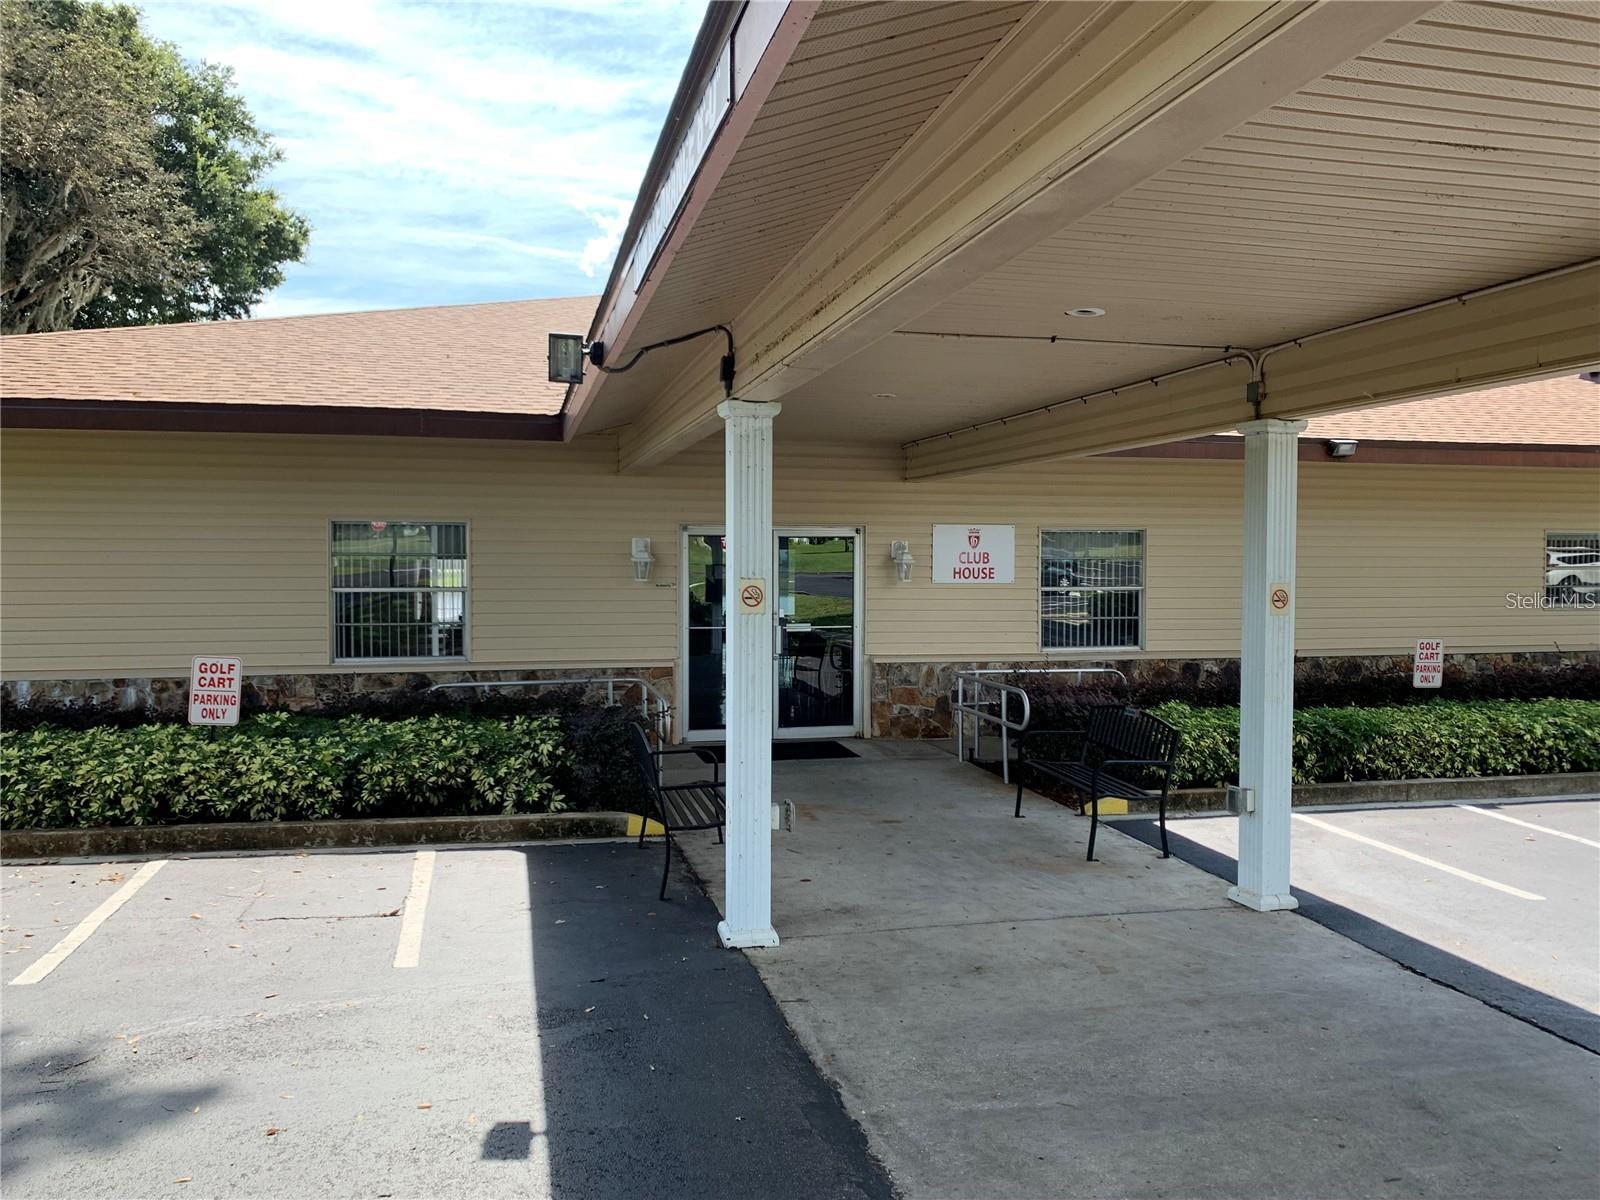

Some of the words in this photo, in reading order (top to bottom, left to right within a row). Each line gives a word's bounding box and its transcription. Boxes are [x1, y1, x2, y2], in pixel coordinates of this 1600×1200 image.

[959, 552, 990, 564] CLUB
[953, 568, 995, 580] HOUSE
[1419, 642, 1440, 650] GOLF
[1419, 652, 1440, 660] CART
[199, 663, 235, 674] GOLF
[1416, 665, 1440, 673] PARKING
[198, 677, 234, 688] CART
[1420, 675, 1435, 683] ONLY
[193, 694, 236, 705] PARKING
[201, 708, 227, 720] ONLY
